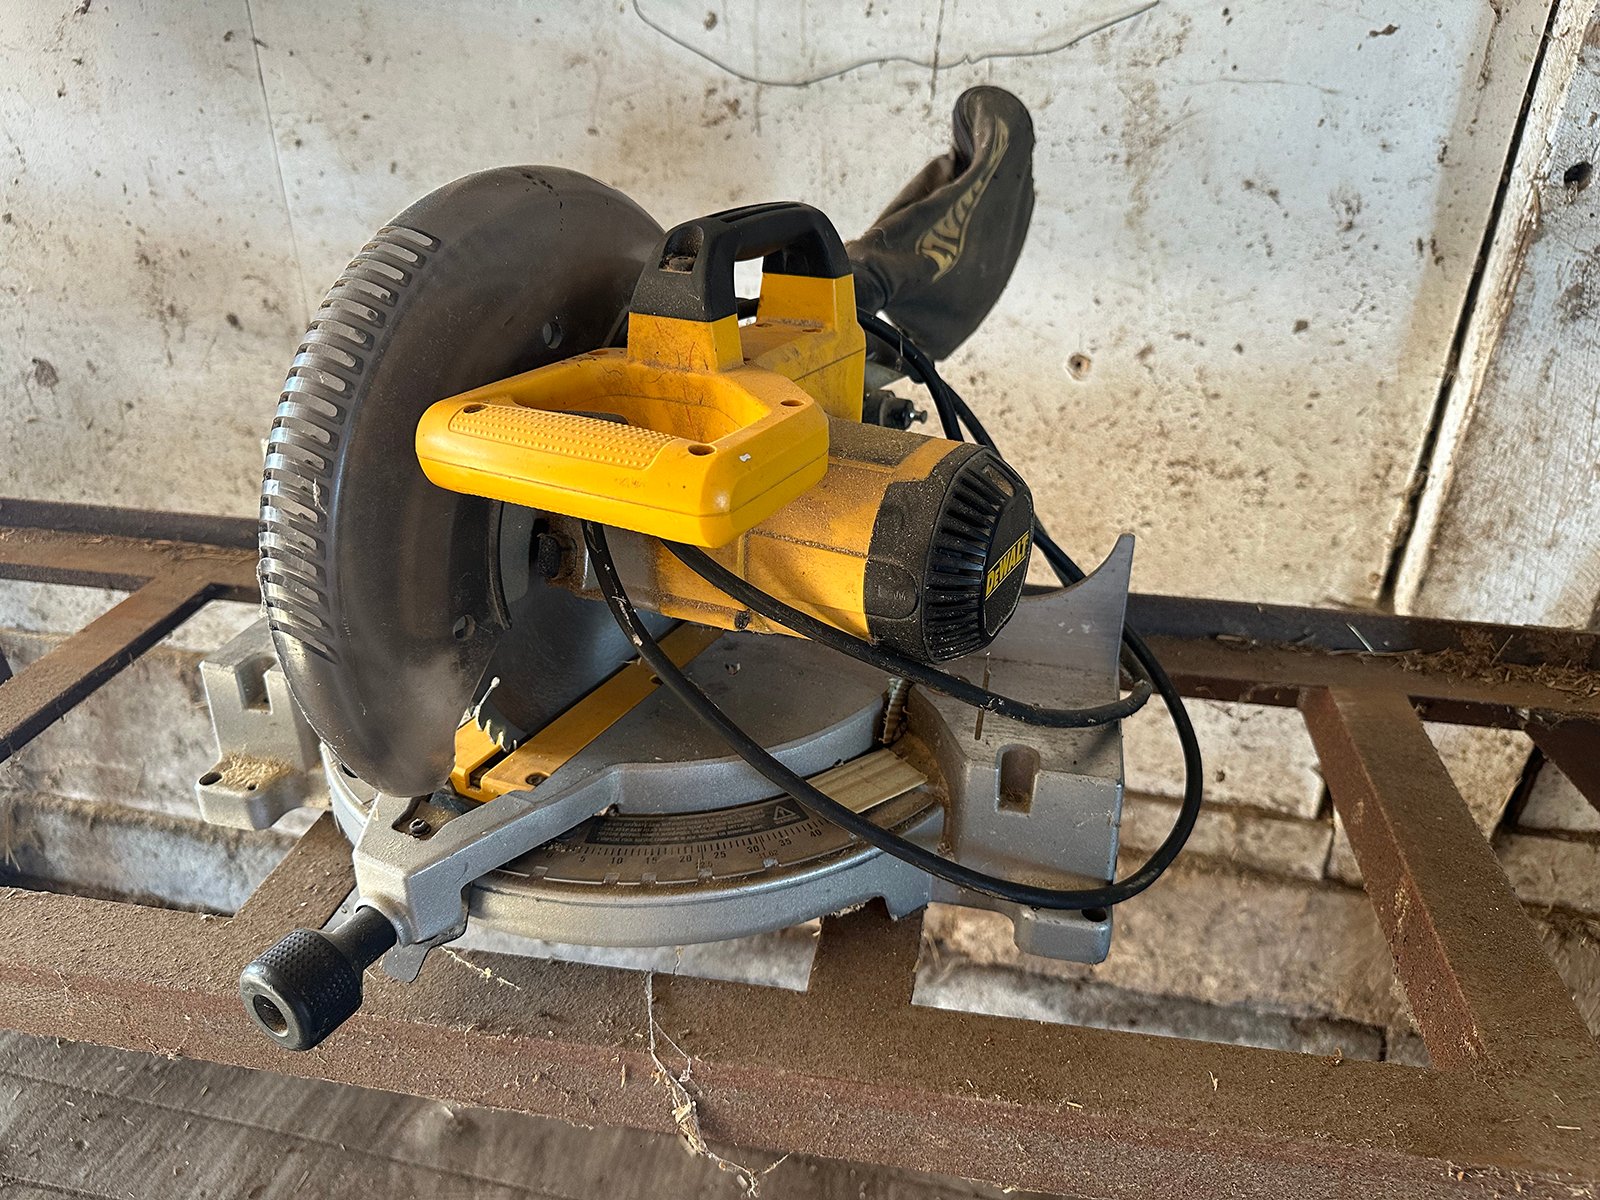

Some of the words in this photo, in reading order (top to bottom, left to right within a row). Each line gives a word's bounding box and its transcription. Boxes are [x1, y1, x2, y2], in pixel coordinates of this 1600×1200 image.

[611, 857, 624, 865] 10
[646, 856, 658, 865] 15
[679, 855, 692, 863] 20
[713, 850, 727, 859] 25
[746, 845, 760, 854] 30
[778, 838, 792, 847] 35
[810, 829, 822, 838] 40
